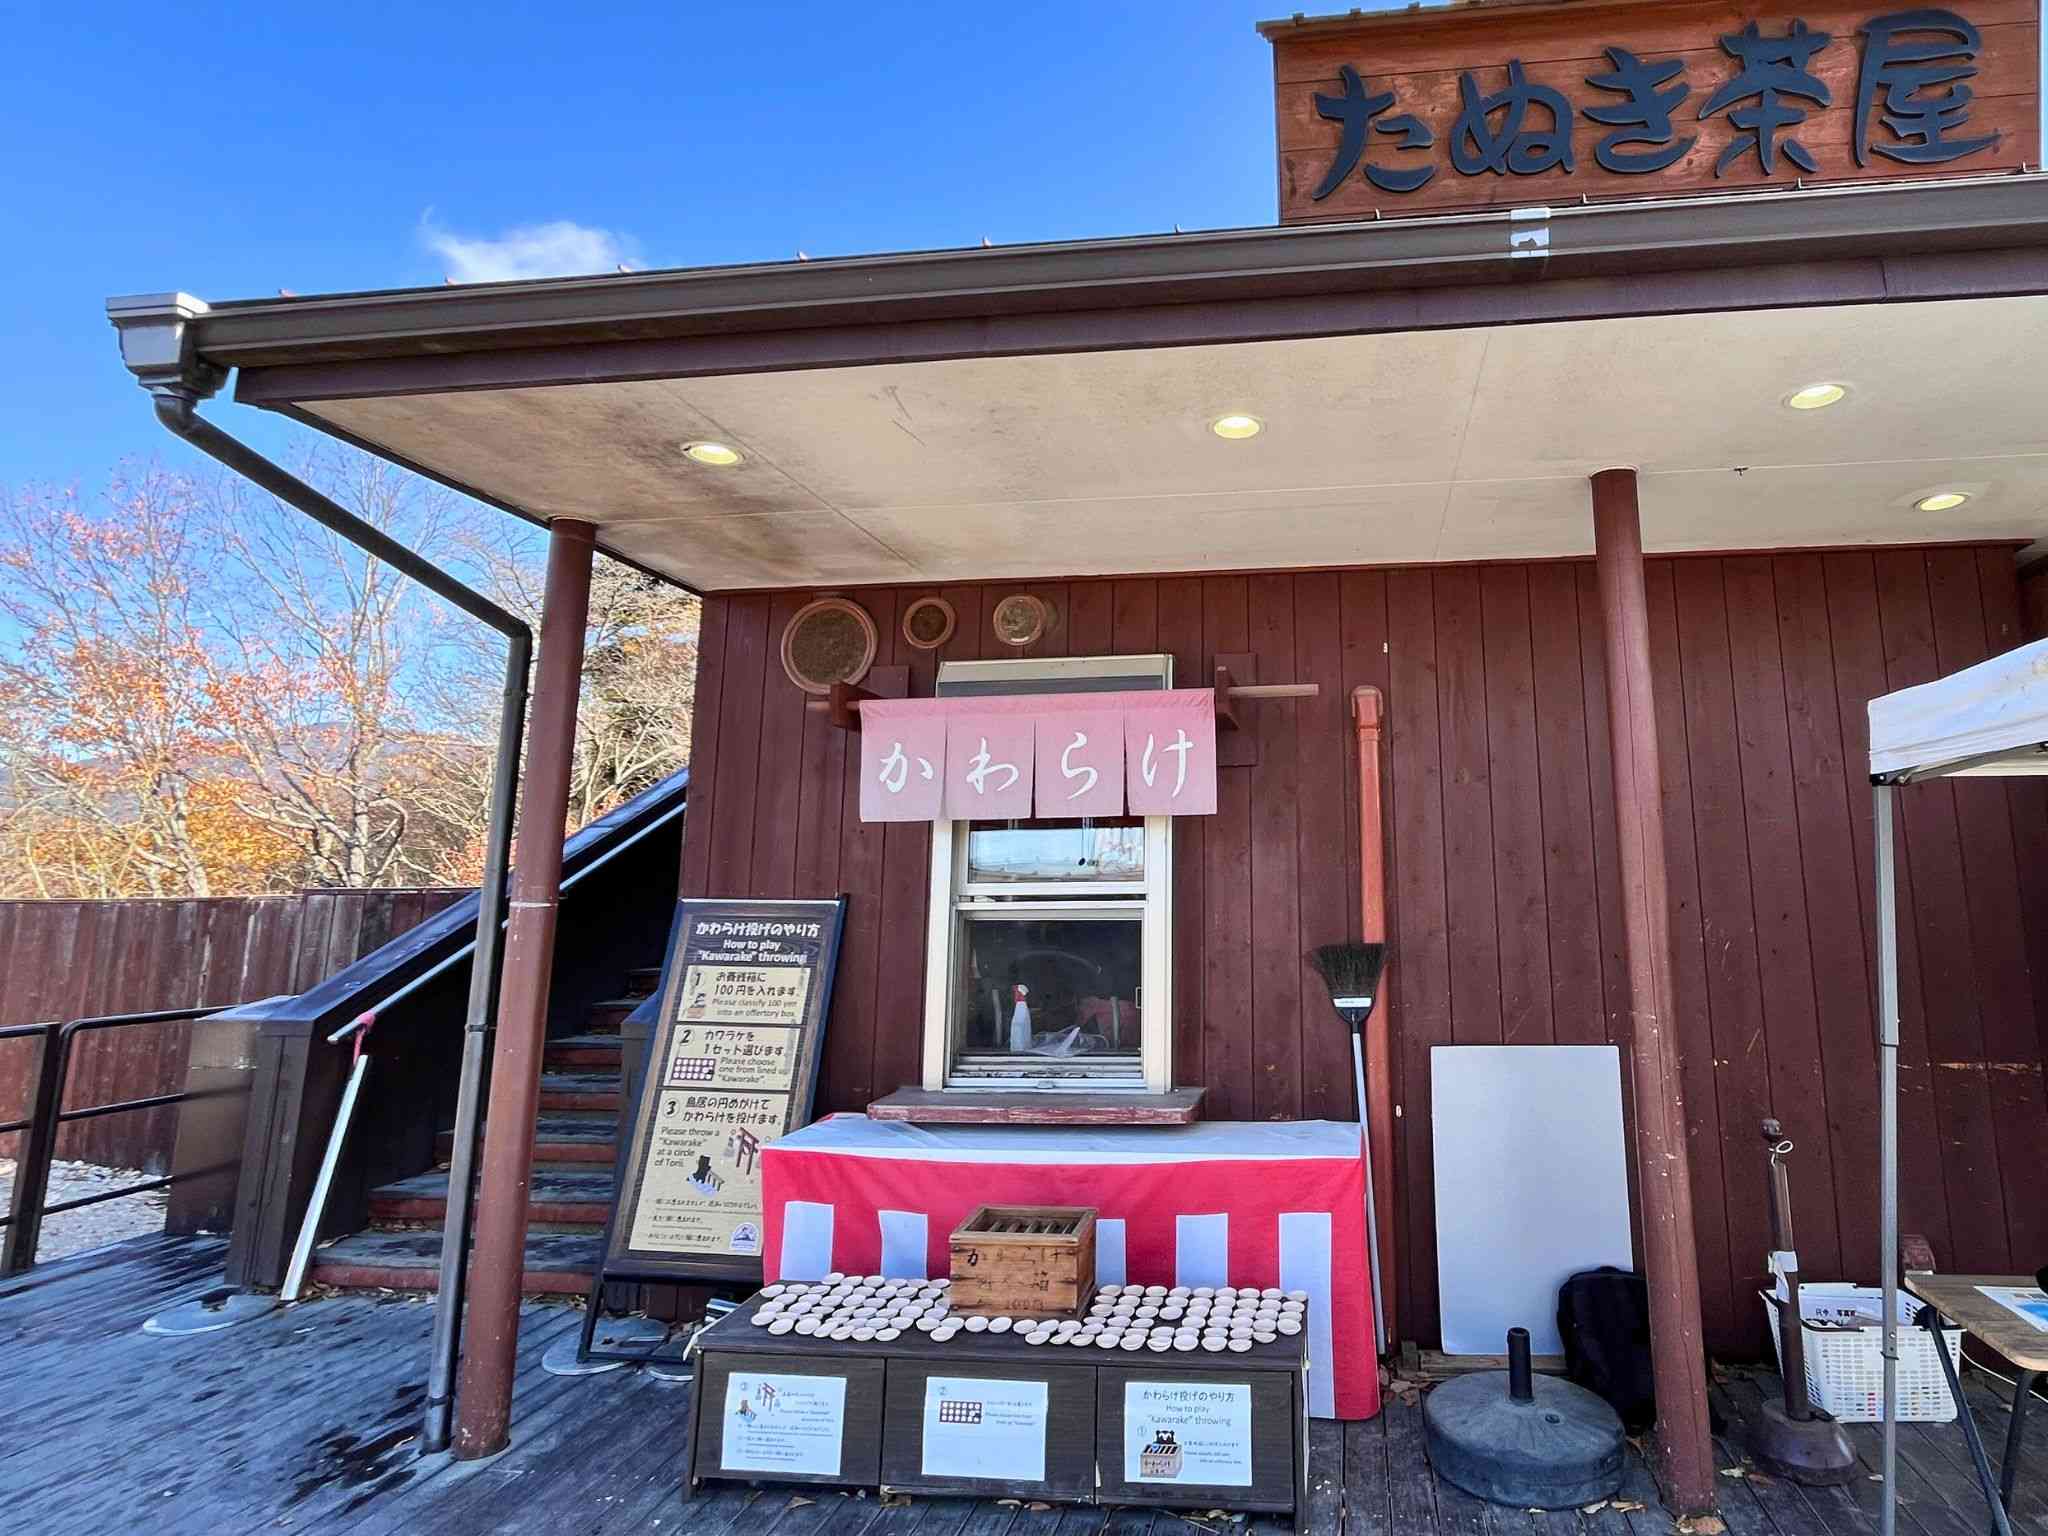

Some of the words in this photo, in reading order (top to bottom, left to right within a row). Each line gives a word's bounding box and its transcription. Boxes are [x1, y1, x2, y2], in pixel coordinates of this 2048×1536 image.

[1312, 9, 2000, 201] たぬき茶屋
[880, 729, 1193, 800] かわらけ
[696, 922, 820, 938] かわらけ投げのやり方
[723, 940, 745, 949] How
[747, 940, 758, 949] to
[759, 940, 781, 951] play
[759, 952, 807, 964] throwing
[712, 998, 737, 1006] Please
[704, 1030, 755, 1042] カワラケを
[720, 1057, 745, 1065] Please
[661, 1127, 686, 1136] Please
[689, 1127, 713, 1136] throw
[1143, 1390, 1235, 1402] かわらけ投げのやり方
